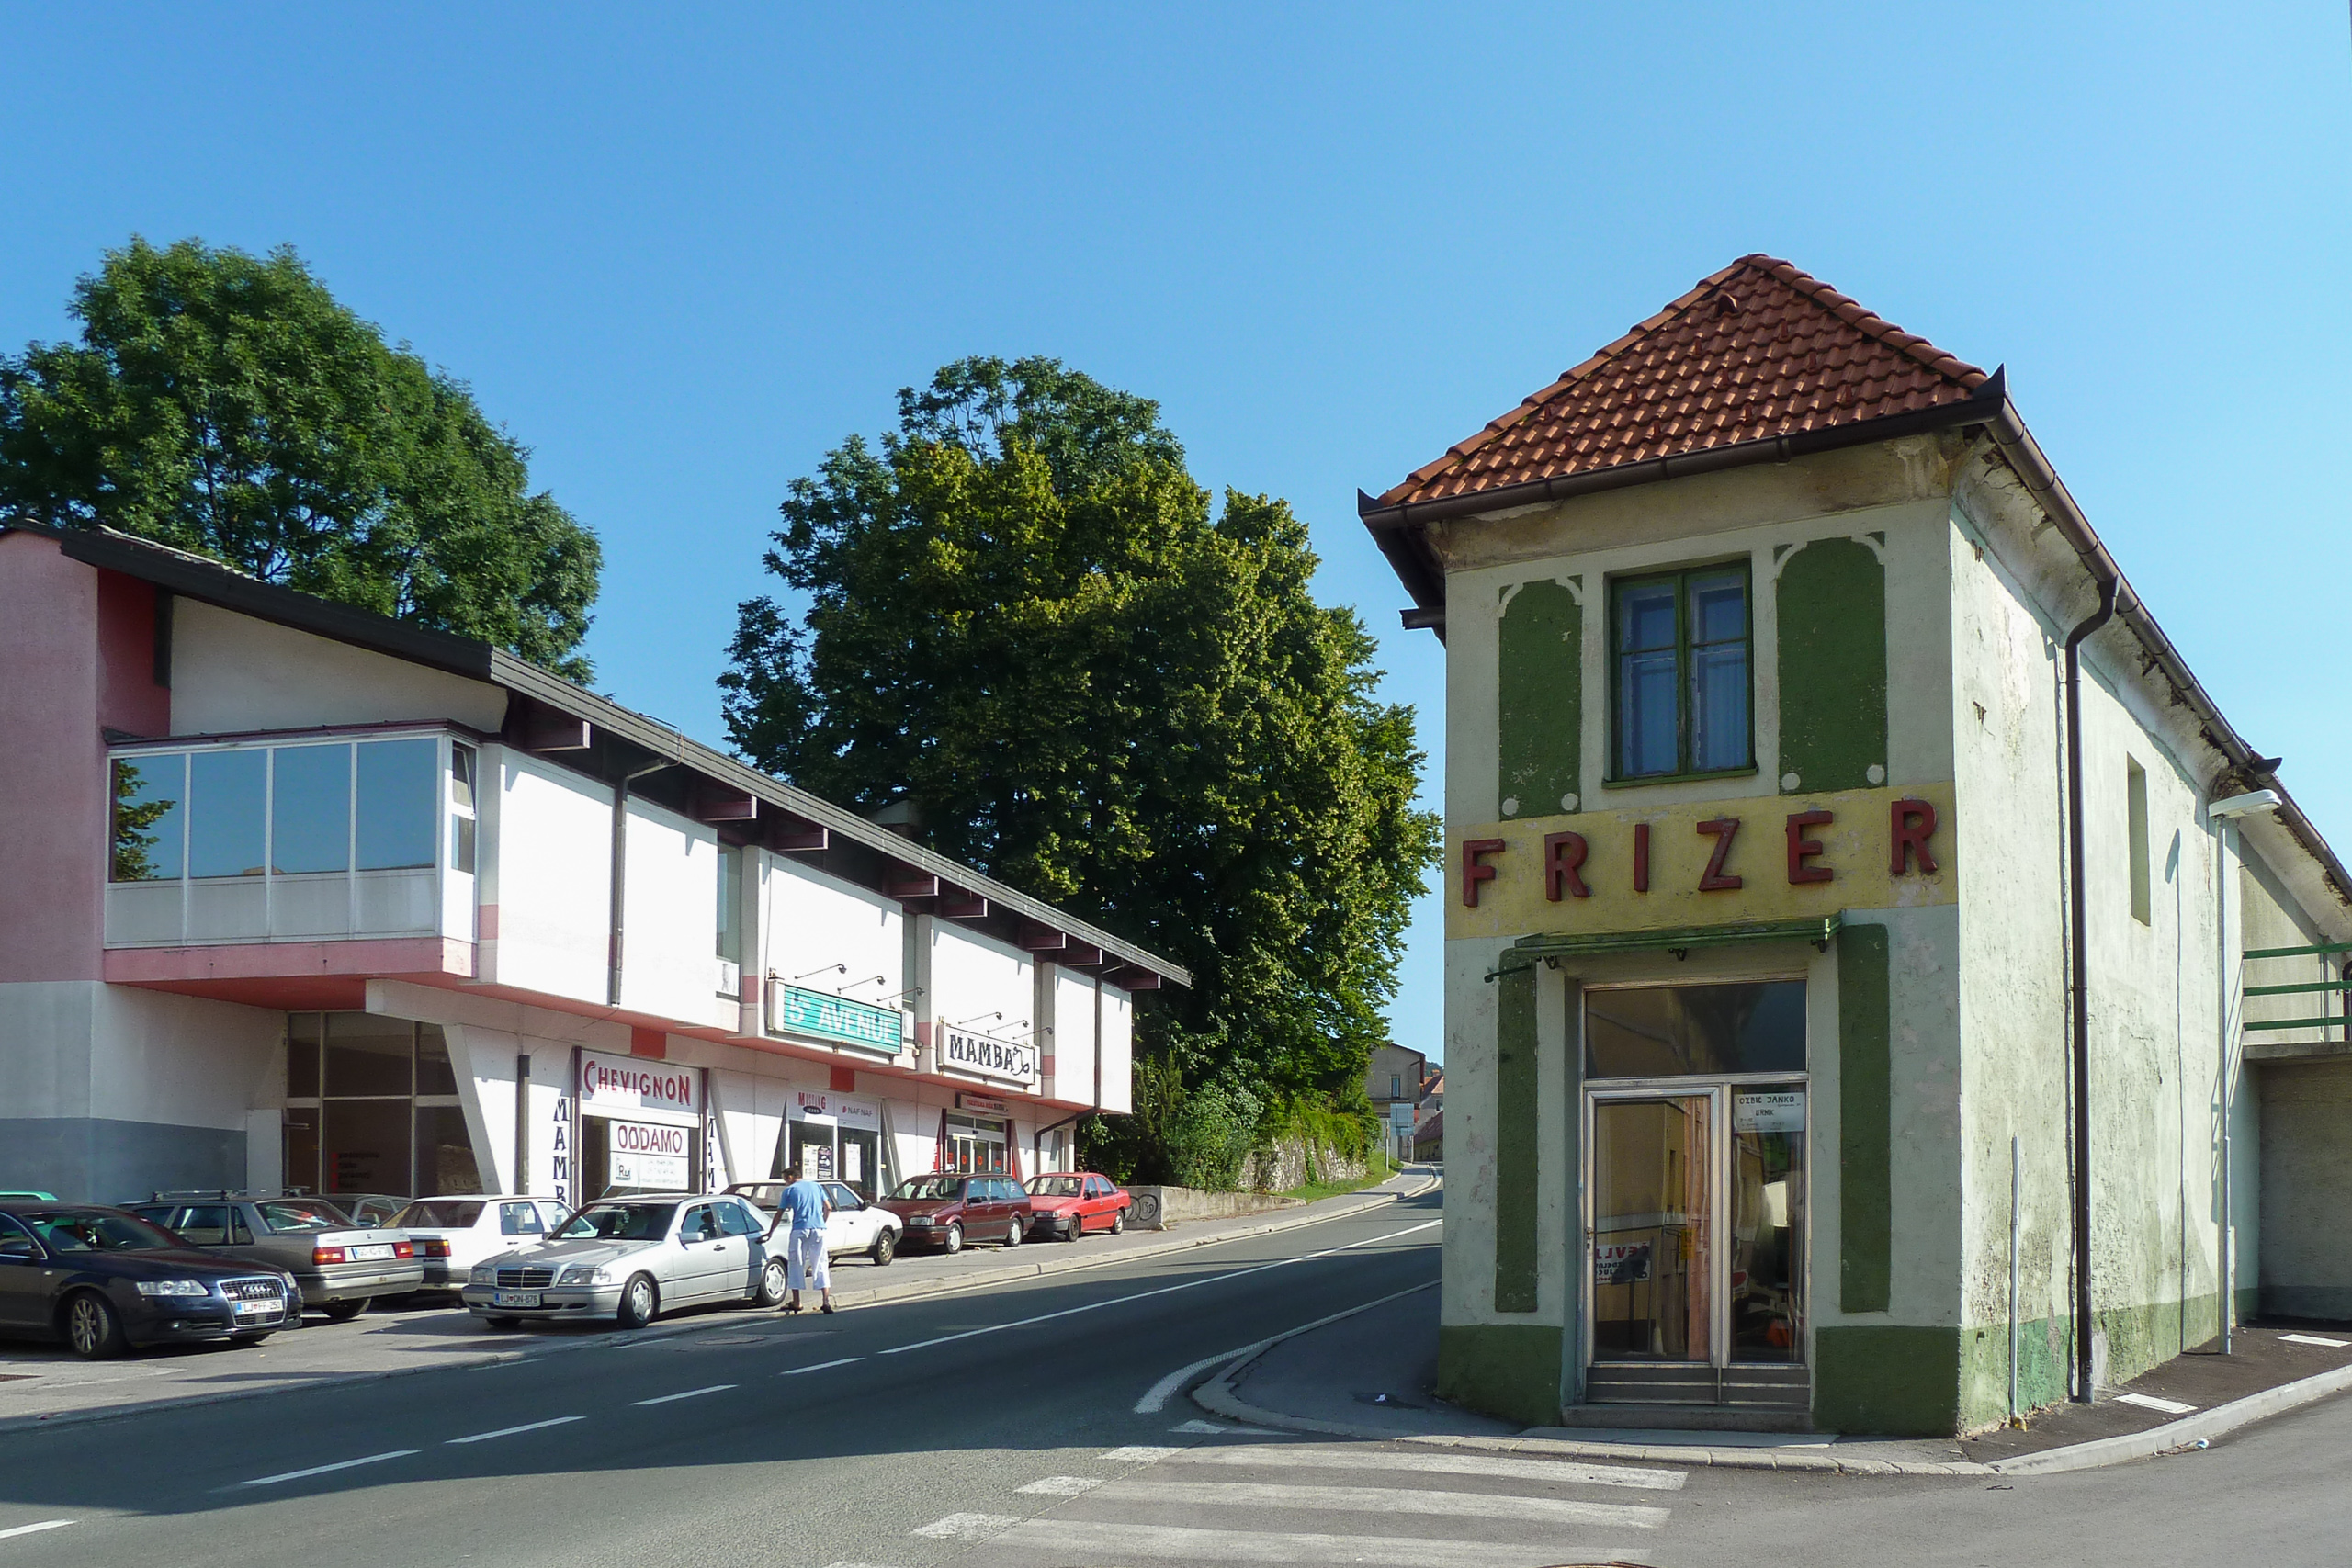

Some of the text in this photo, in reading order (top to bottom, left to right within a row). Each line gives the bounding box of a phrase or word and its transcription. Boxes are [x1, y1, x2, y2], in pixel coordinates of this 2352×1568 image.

[1462, 797, 1939, 908] FRIZER
[818, 1003, 896, 1043] AVENUE
[949, 1034, 1015, 1073] MAMBA
[583, 1059, 692, 1107] CHEVIGNON
[1767, 1095, 1795, 1103] JANKO
[617, 1124, 683, 1154] ODDAMO
